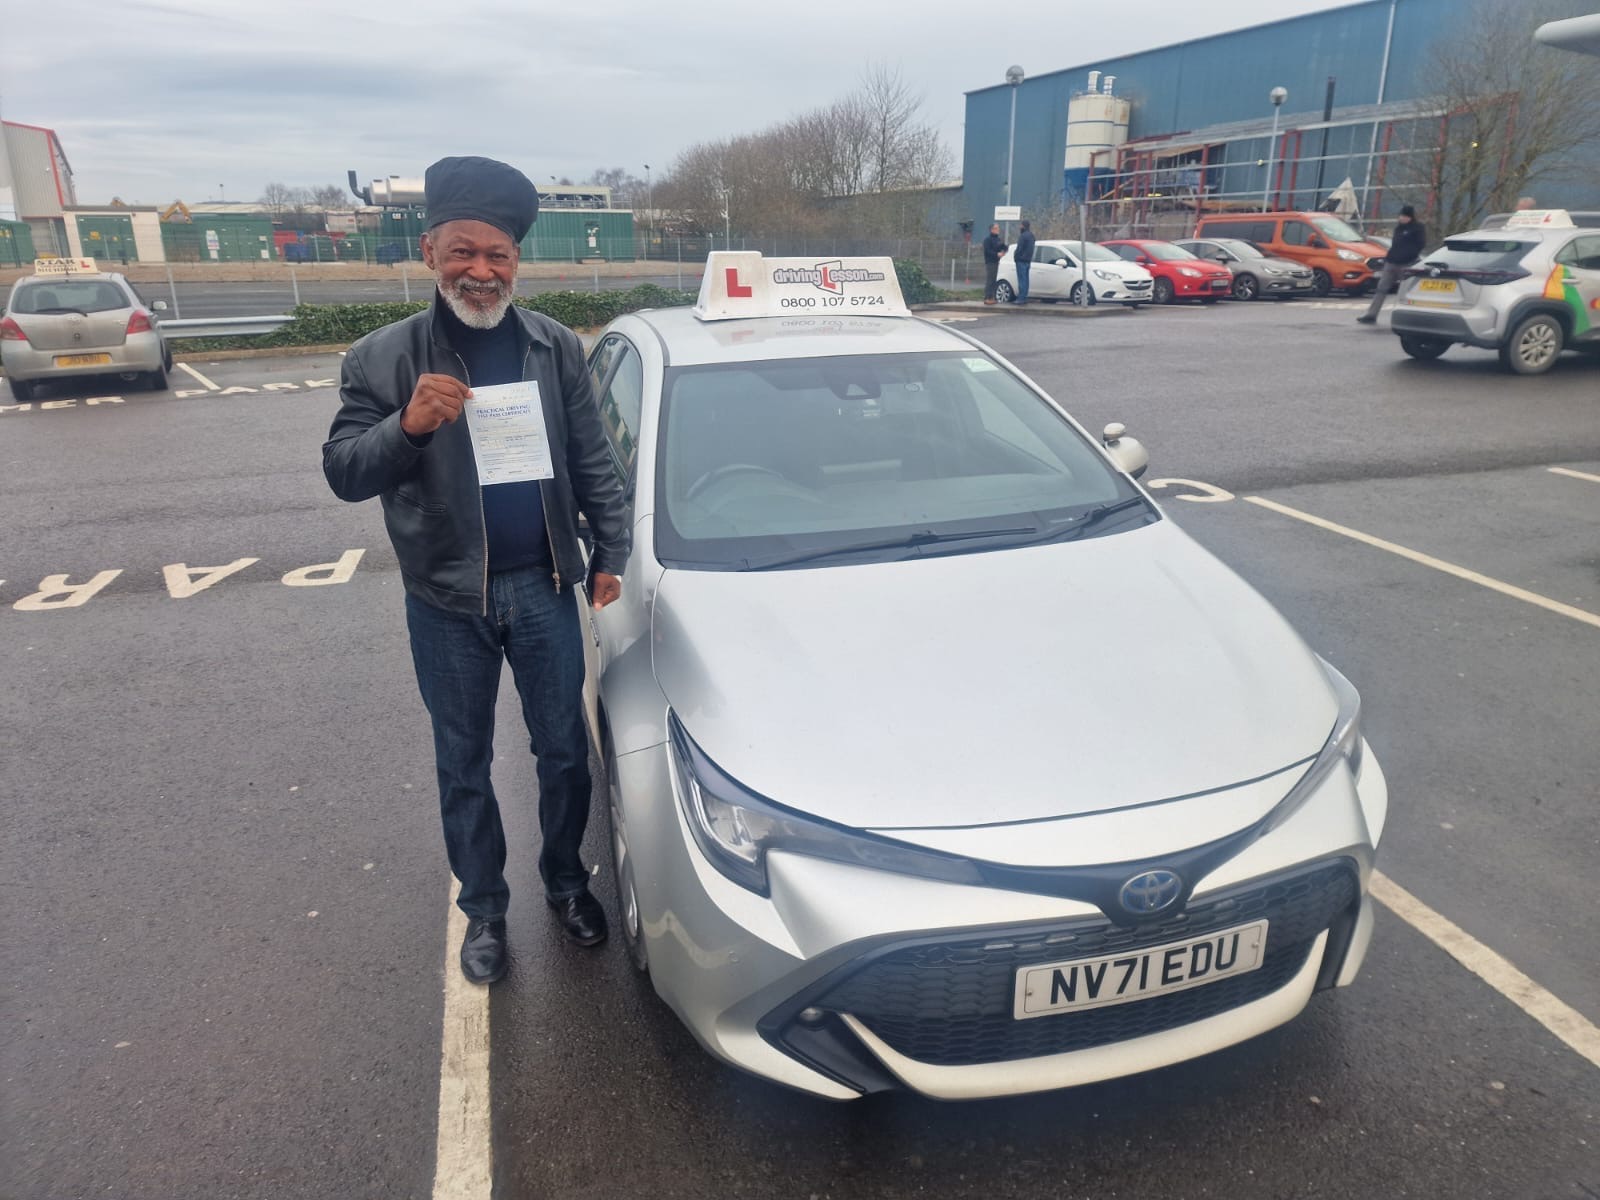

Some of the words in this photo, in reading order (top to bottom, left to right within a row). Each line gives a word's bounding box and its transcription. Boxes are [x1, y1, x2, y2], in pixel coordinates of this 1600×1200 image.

[725, 268, 752, 297] L
[781, 297, 816, 307] 0800
[822, 296, 845, 307] 107
[850, 295, 885, 306] 5724
[1050, 956, 1150, 1005] NV71
[1161, 934, 1240, 985] EDU
